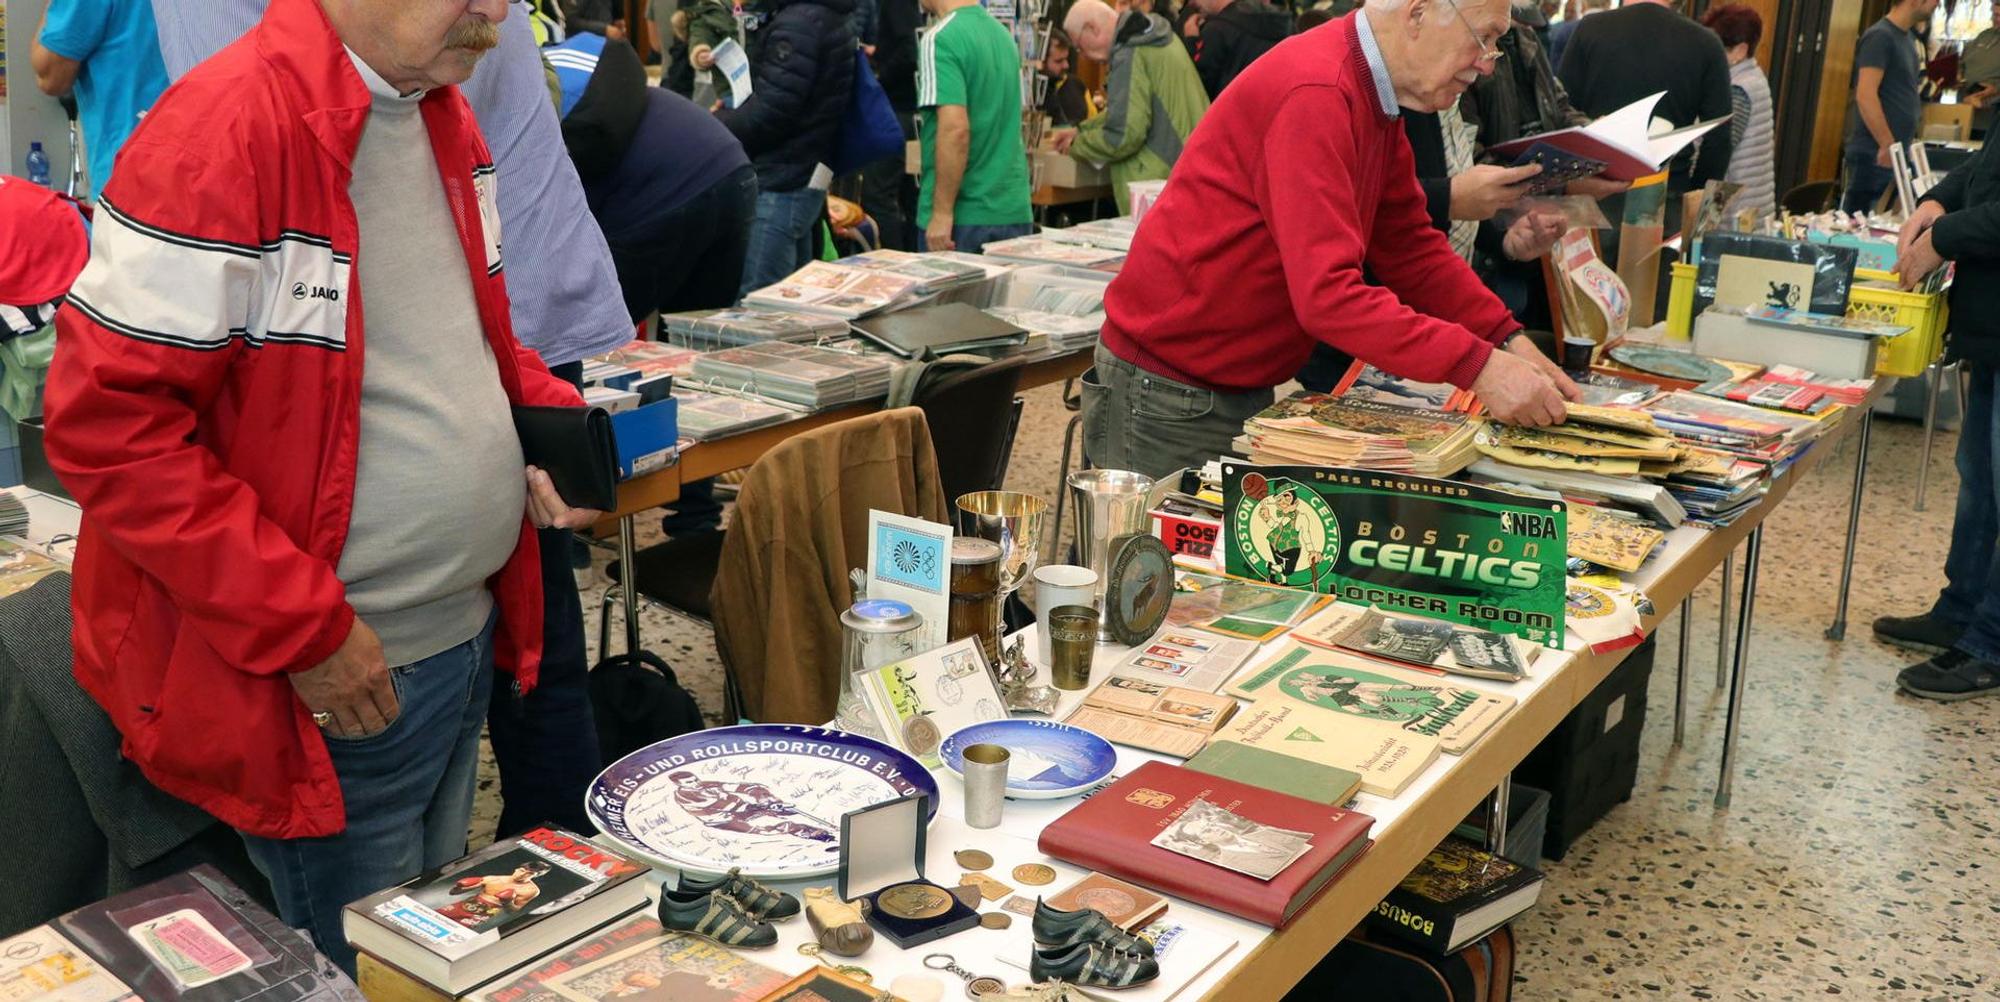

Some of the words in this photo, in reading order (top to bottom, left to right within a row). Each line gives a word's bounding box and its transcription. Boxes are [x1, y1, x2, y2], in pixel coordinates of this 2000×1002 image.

[1315, 471, 1361, 485] PASS
[1372, 479, 1469, 496] REQUIRED
[1238, 499, 1260, 565] BOSTON
[1310, 497, 1337, 563] CELTICS
[1511, 511, 1558, 541] NBA
[1349, 539, 1542, 589] CELTICS
[1328, 584, 1447, 614] LOCKER
[691, 740, 871, 766] ROLLSPORTCLUB
[522, 827, 637, 877] ROCKY
[1373, 901, 1434, 936] BORUS
